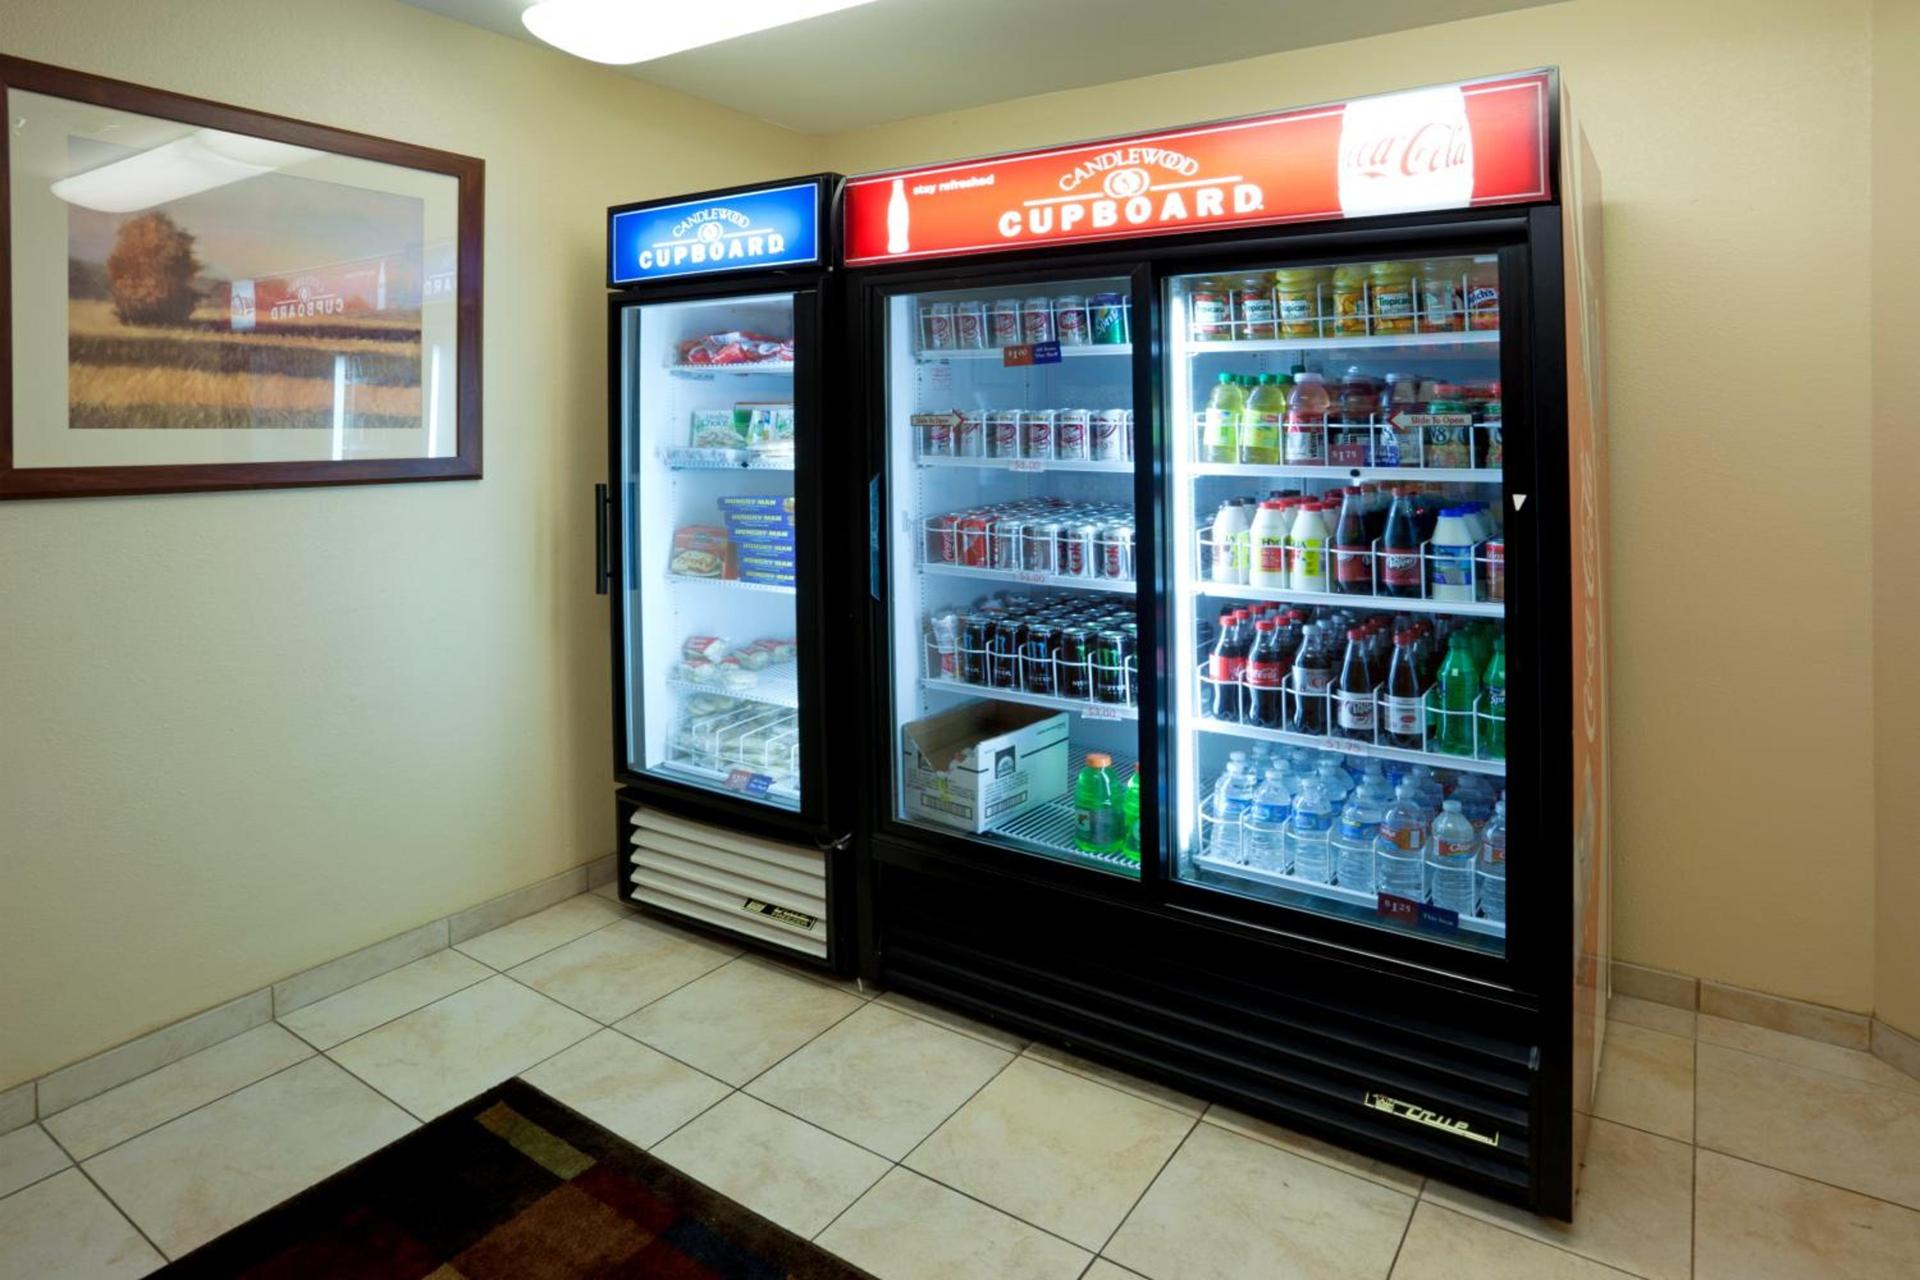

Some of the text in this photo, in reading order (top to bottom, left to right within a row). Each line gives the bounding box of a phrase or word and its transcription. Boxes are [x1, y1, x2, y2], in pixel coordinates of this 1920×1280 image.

[939, 173, 995, 191] refreshed
[1058, 147, 1199, 191] CANDLEWOOD
[672, 208, 750, 237] CANDLEWOOD
[998, 184, 1264, 237] CUPBOARD
[638, 234, 786, 269] CUPBOARD
[1443, 416, 1465, 425] Open
